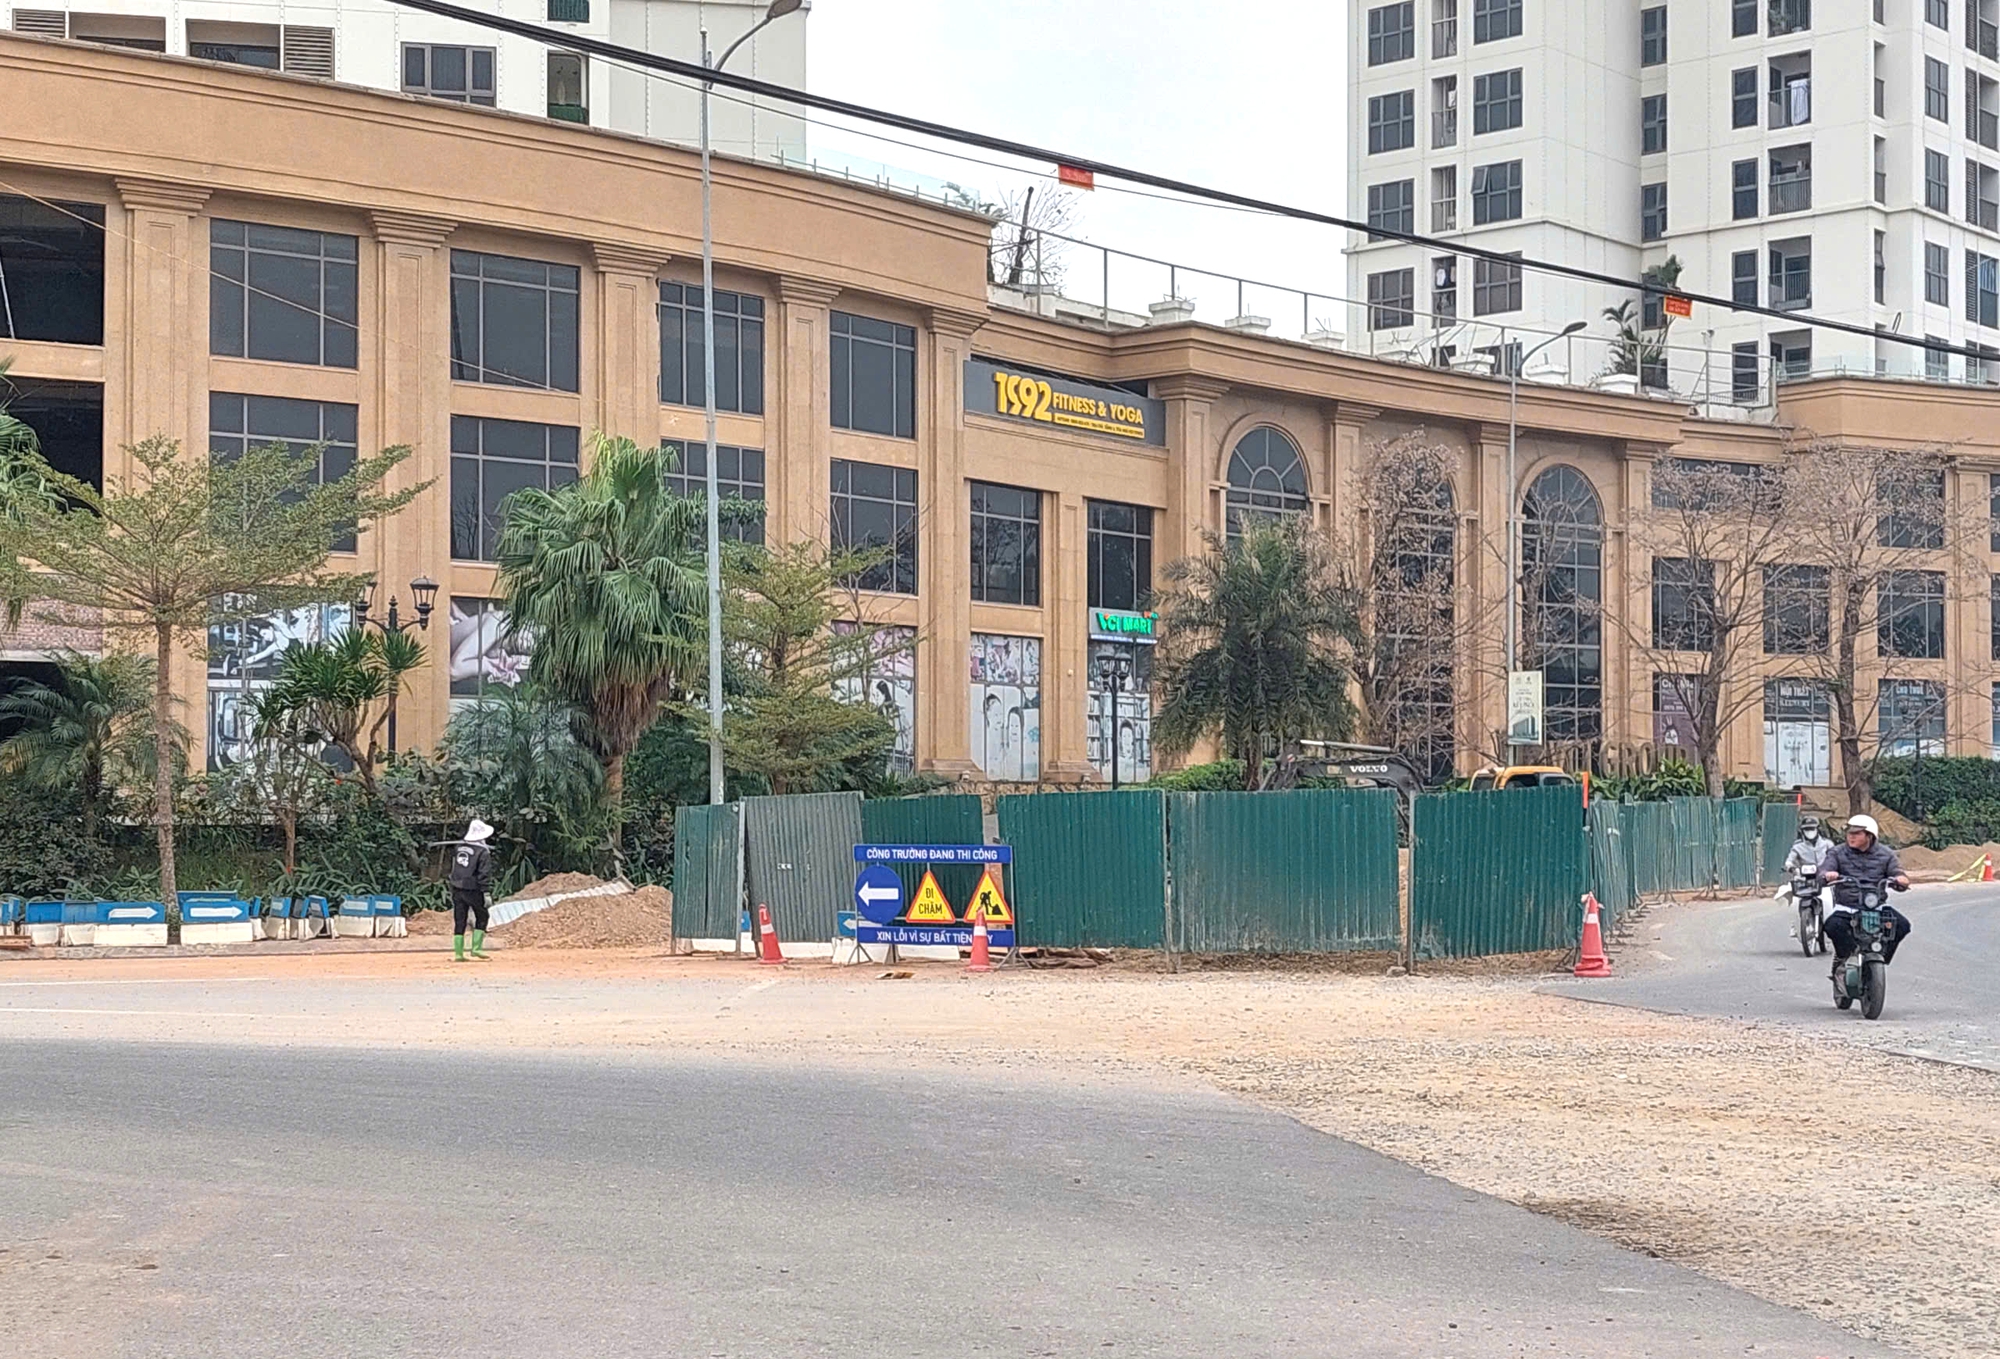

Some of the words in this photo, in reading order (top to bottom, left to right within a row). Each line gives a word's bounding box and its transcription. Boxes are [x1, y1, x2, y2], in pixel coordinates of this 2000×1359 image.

[1053, 392, 1096, 415] FITNESS
[1097, 400, 1107, 418] &
[1109, 403, 1144, 425] YOGA
[1122, 616, 1152, 635] MART
[1349, 764, 1388, 773] VOLVO
[866, 847, 891, 859] CÔNG
[892, 847, 927, 860] TRƯỜNG
[929, 849, 955, 860] ĐANG
[956, 849, 971, 860] THI
[972, 848, 998, 860] CÔNG
[925, 887, 934, 899] ĐI
[918, 901, 943, 917] CHẬM
[876, 931, 892, 941] XIN
[893, 928, 908, 942] LỖI
[909, 930, 918, 942] VÌ
[919, 931, 933, 944] SỰ
[934, 930, 952, 943] BẤT
[952, 931, 973, 945] TIỆN
